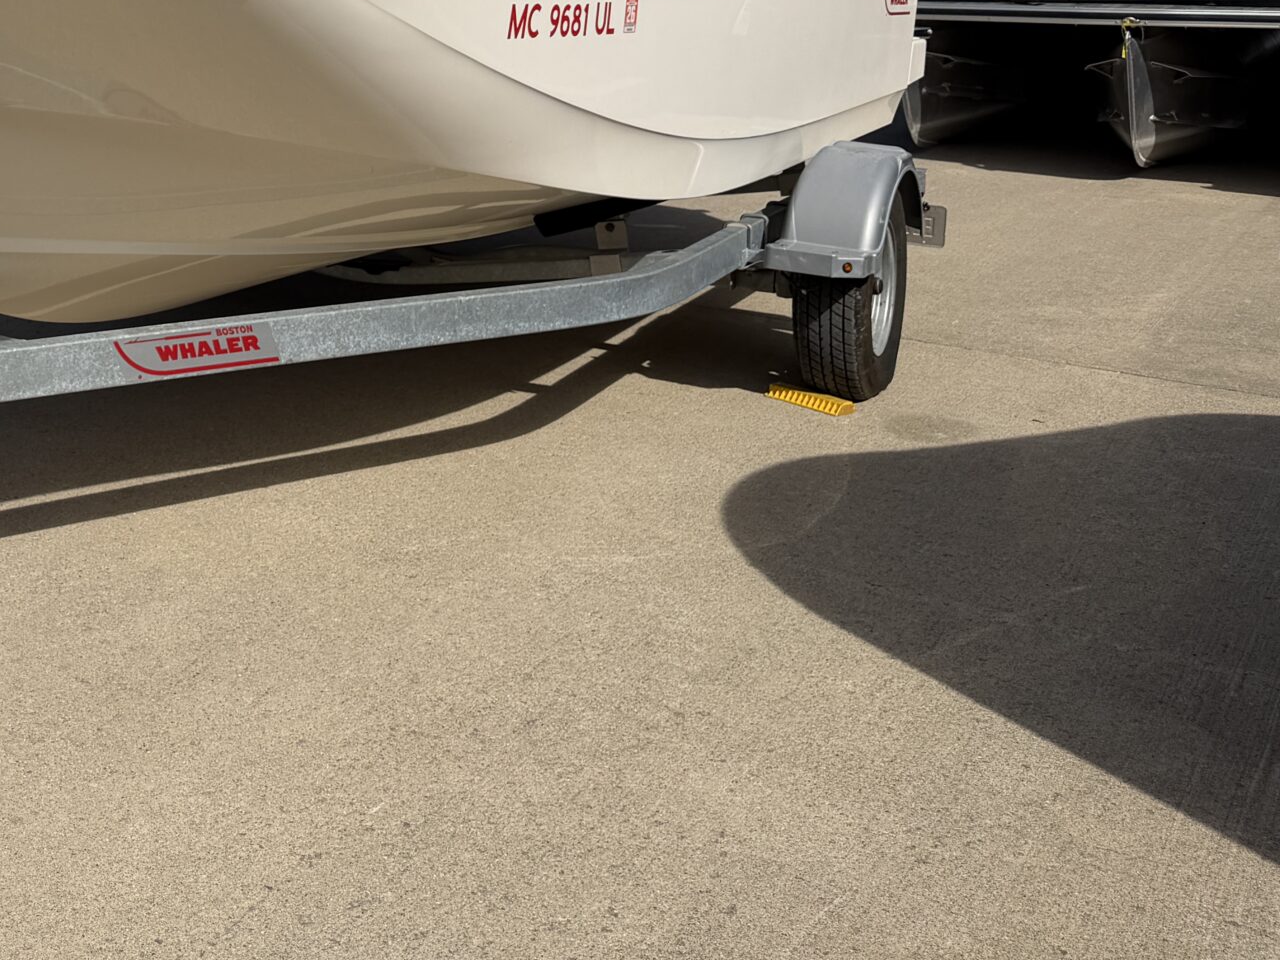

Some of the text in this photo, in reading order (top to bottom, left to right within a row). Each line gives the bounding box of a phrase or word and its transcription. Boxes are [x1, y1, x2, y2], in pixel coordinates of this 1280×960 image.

[507, 2, 615, 39] MC 9681 UL
[216, 325, 253, 337] BOSTON
[155, 335, 261, 362] WHALER
